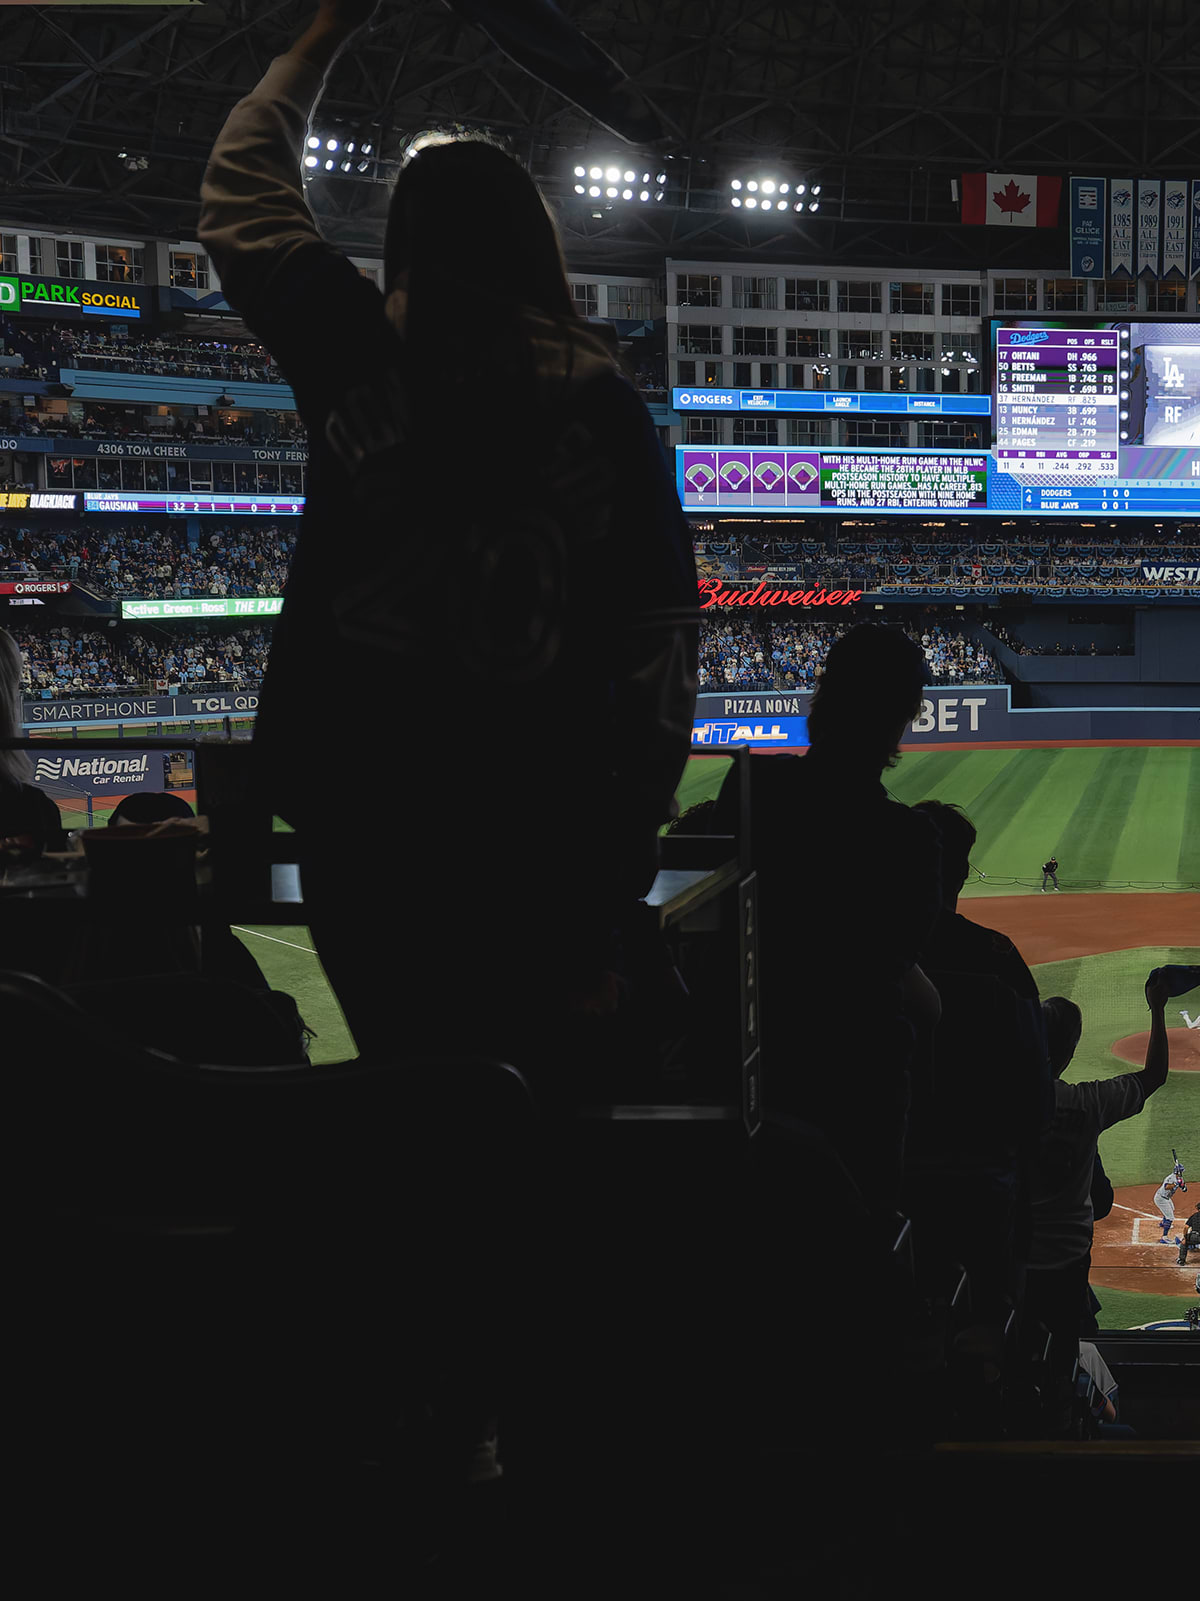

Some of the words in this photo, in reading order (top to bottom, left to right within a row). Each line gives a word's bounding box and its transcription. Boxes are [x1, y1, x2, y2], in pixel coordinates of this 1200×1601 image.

[1113, 214, 1131, 227] 1985
[1140, 215, 1158, 228] 1989
[1167, 216, 1184, 228] 1991
[21, 281, 80, 303] PARK
[81, 292, 140, 309] SOCIAL
[1010, 331, 1049, 345] Dodgers
[1000, 352, 1007, 360] 17
[1012, 352, 1040, 360] OHTANI
[1080, 353, 1097, 361] .966
[999, 362, 1008, 370] 50
[1012, 363, 1035, 371] BETTS
[1080, 364, 1097, 372] .763
[1163, 357, 1184, 387] LA
[1012, 374, 1047, 382] FREEMAN
[1080, 375, 1096, 383] .742
[1000, 384, 1007, 392] 16
[1012, 384, 1035, 392] SMITH
[1080, 385, 1097, 393] .698
[692, 395, 733, 405] ROGERS
[1012, 406, 1038, 414] MUNCY
[1165, 406, 1182, 423] RF
[1012, 416, 1055, 425] HERNÁNDEZ
[1012, 438, 1036, 446] PAGES
[97, 444, 124, 454] 4306
[126, 445, 150, 455] TOM
[153, 446, 187, 457] CHEEK
[253, 450, 280, 460] TONY
[823, 456, 841, 464] WITH
[842, 456, 855, 464] HIS
[857, 456, 901, 465] MULTI-HOME
[902, 457, 916, 465] RUN
[918, 457, 938, 465] GAME
[940, 457, 947, 465] IN
[949, 457, 962, 465] THE
[881, 465, 894, 473] THE
[896, 465, 914, 473] 28TH
[916, 465, 942, 473] PLAYER
[944, 465, 952, 473] IN
[832, 473, 877, 481] POSTSEASON
[879, 473, 909, 481] HISTORY
[911, 474, 920, 482] TO
[922, 474, 940, 482] HAVE
[942, 474, 975, 482] MULTIPLE
[824, 481, 869, 490] MULTI-HOME
[870, 482, 885, 490] RUN
[933, 482, 939, 491] A
[939, 482, 966, 491] CAREER
[831, 490, 846, 498] OPS
[848, 490, 855, 498] IN
[857, 490, 871, 498] THE
[872, 490, 916, 498] POSTSEASON
[918, 491, 936, 499] WITH
[938, 491, 954, 499] NINE
[956, 491, 976, 499] HOME
[1041, 489, 1072, 497] DODGERS
[99, 501, 139, 511] GAUSMAN
[837, 498, 859, 507] RUNS,
[860, 498, 875, 507] AND
[877, 498, 885, 507] 27
[903, 499, 937, 508] ENTERING
[939, 499, 969, 508] TONIGHT
[25, 584, 56, 592] ROGERS
[697, 578, 862, 608] Budweiser
[126, 604, 159, 614] Active
[235, 601, 255, 612] THE
[192, 697, 231, 712] TCL
[724, 699, 762, 715] PIZZA
[765, 698, 800, 714] NOVA
[32, 700, 156, 721] SMARTPHONE
[911, 698, 987, 732] BET
[62, 755, 150, 776] National
[93, 776, 110, 785] Car
[113, 774, 144, 783] Rental
